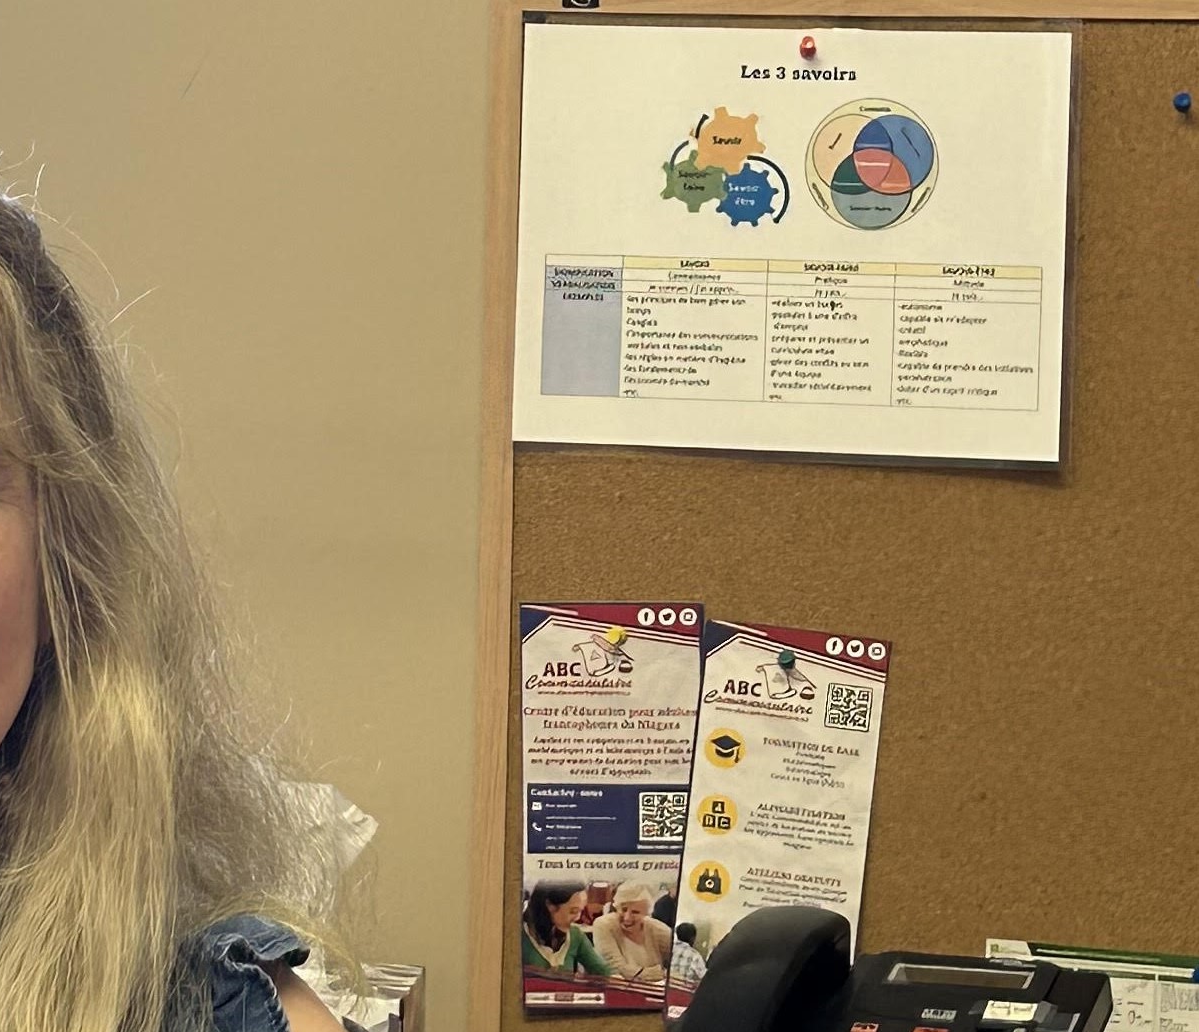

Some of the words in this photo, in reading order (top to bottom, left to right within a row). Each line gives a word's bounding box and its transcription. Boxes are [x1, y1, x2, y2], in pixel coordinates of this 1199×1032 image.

[741, 65, 771, 79] Les
[776, 66, 786, 80] 3
[792, 66, 856, 81] savoirs
[542, 662, 582, 677] ABC
[723, 679, 762, 697] ABC
